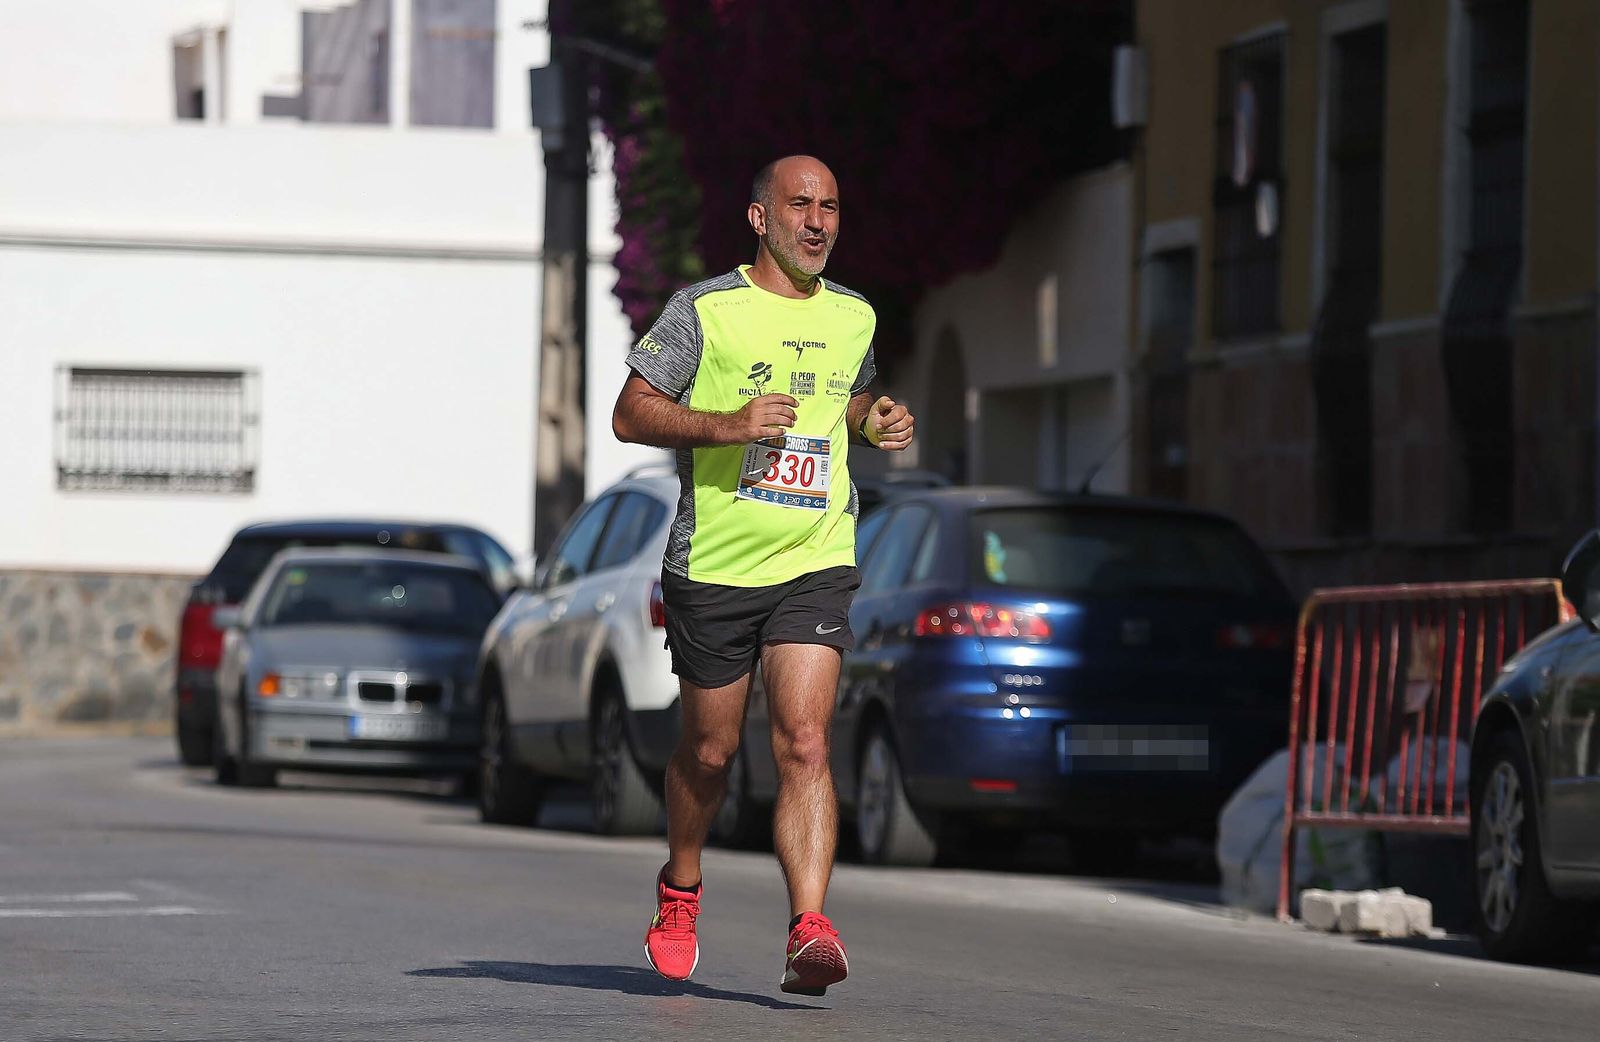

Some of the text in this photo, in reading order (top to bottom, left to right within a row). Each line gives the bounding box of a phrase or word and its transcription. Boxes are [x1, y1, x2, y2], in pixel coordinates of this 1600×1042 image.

[791, 372, 815, 380] EL PEOR
[786, 437, 809, 450] CROSS
[763, 450, 815, 488] 330
